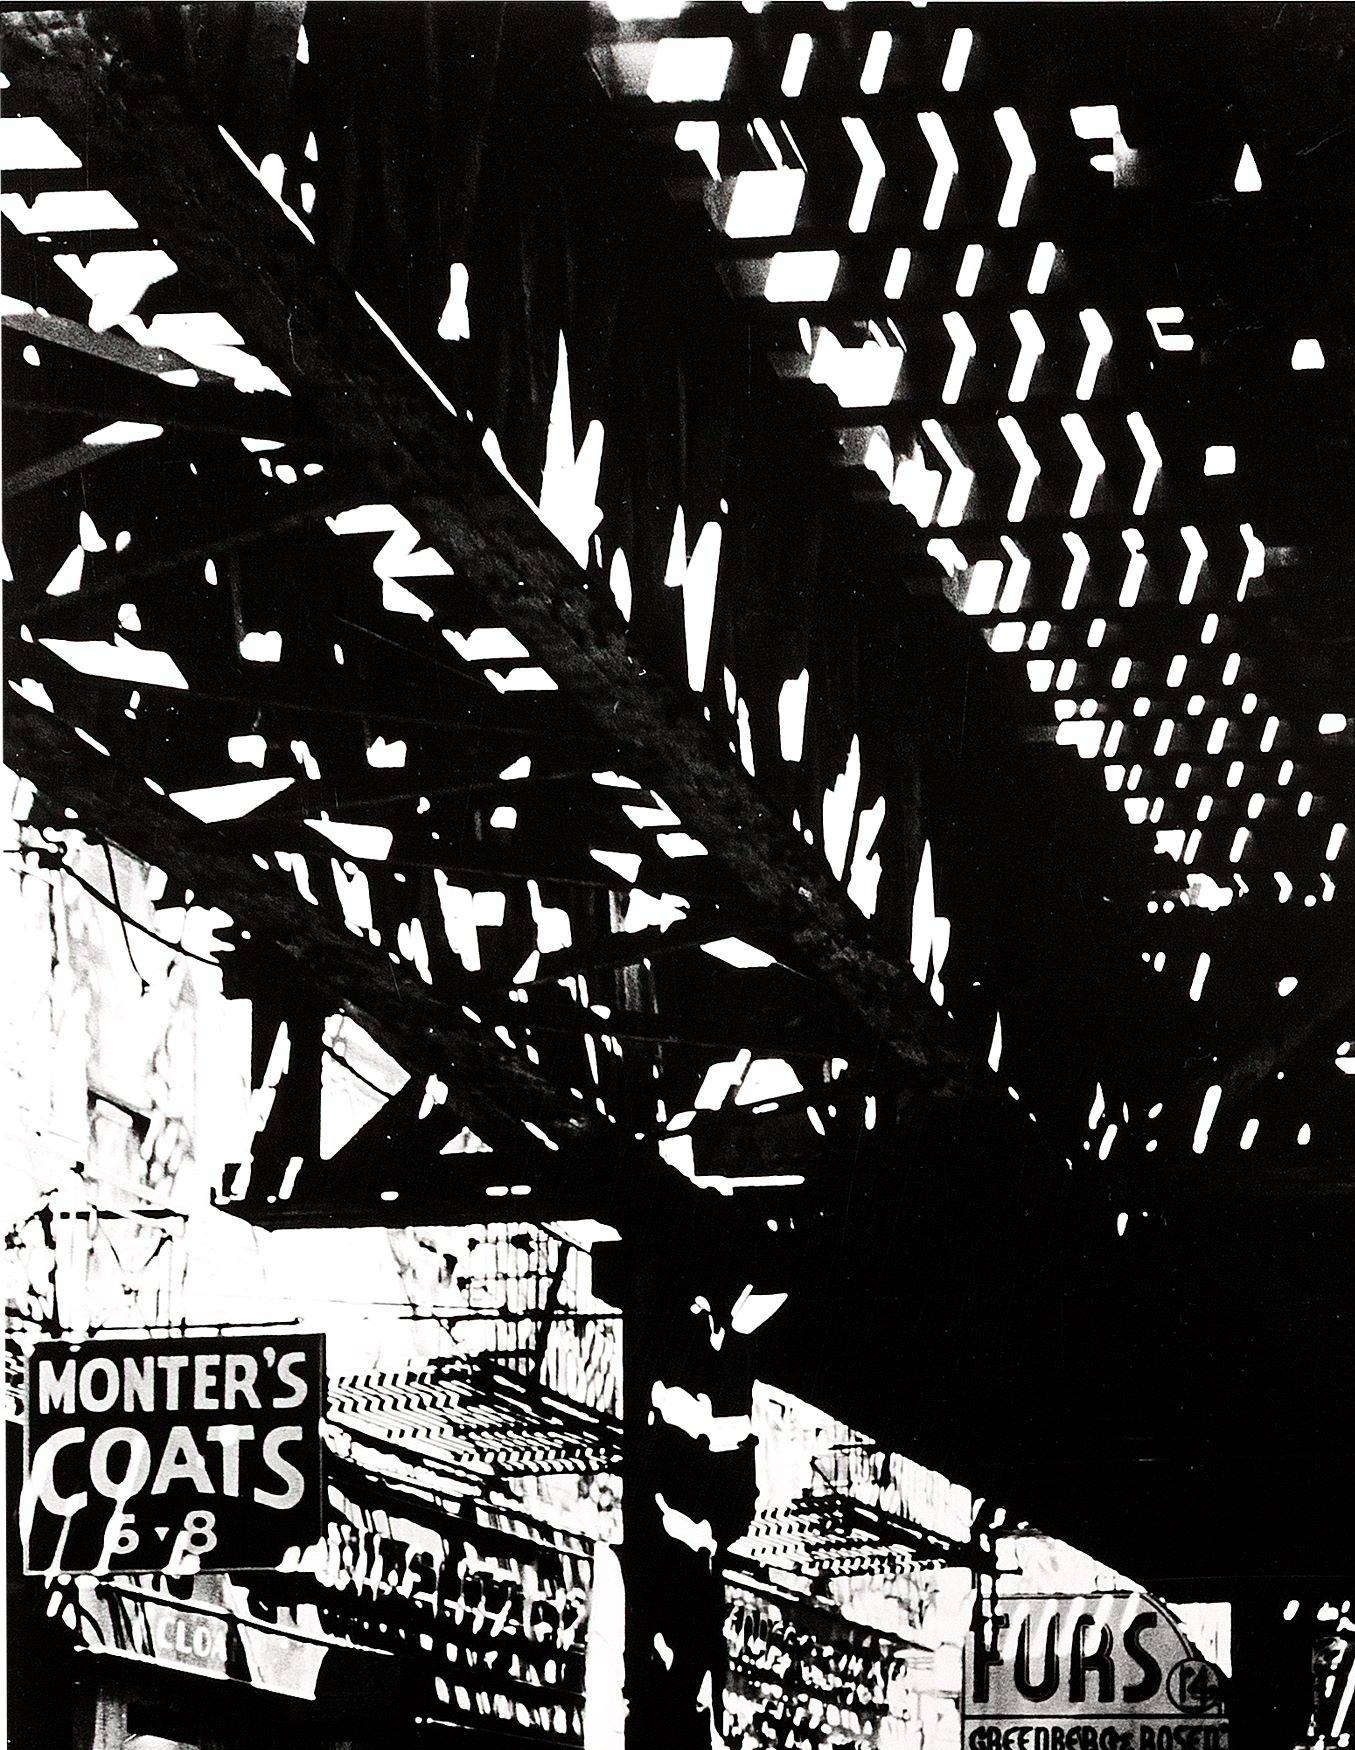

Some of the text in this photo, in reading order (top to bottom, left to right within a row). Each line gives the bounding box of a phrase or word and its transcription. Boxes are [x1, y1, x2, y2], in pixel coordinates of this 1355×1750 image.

[38, 1347, 308, 1415] MONTER'S
[35, 1424, 305, 1516] COATS
[972, 1610, 1163, 1704] FURS
